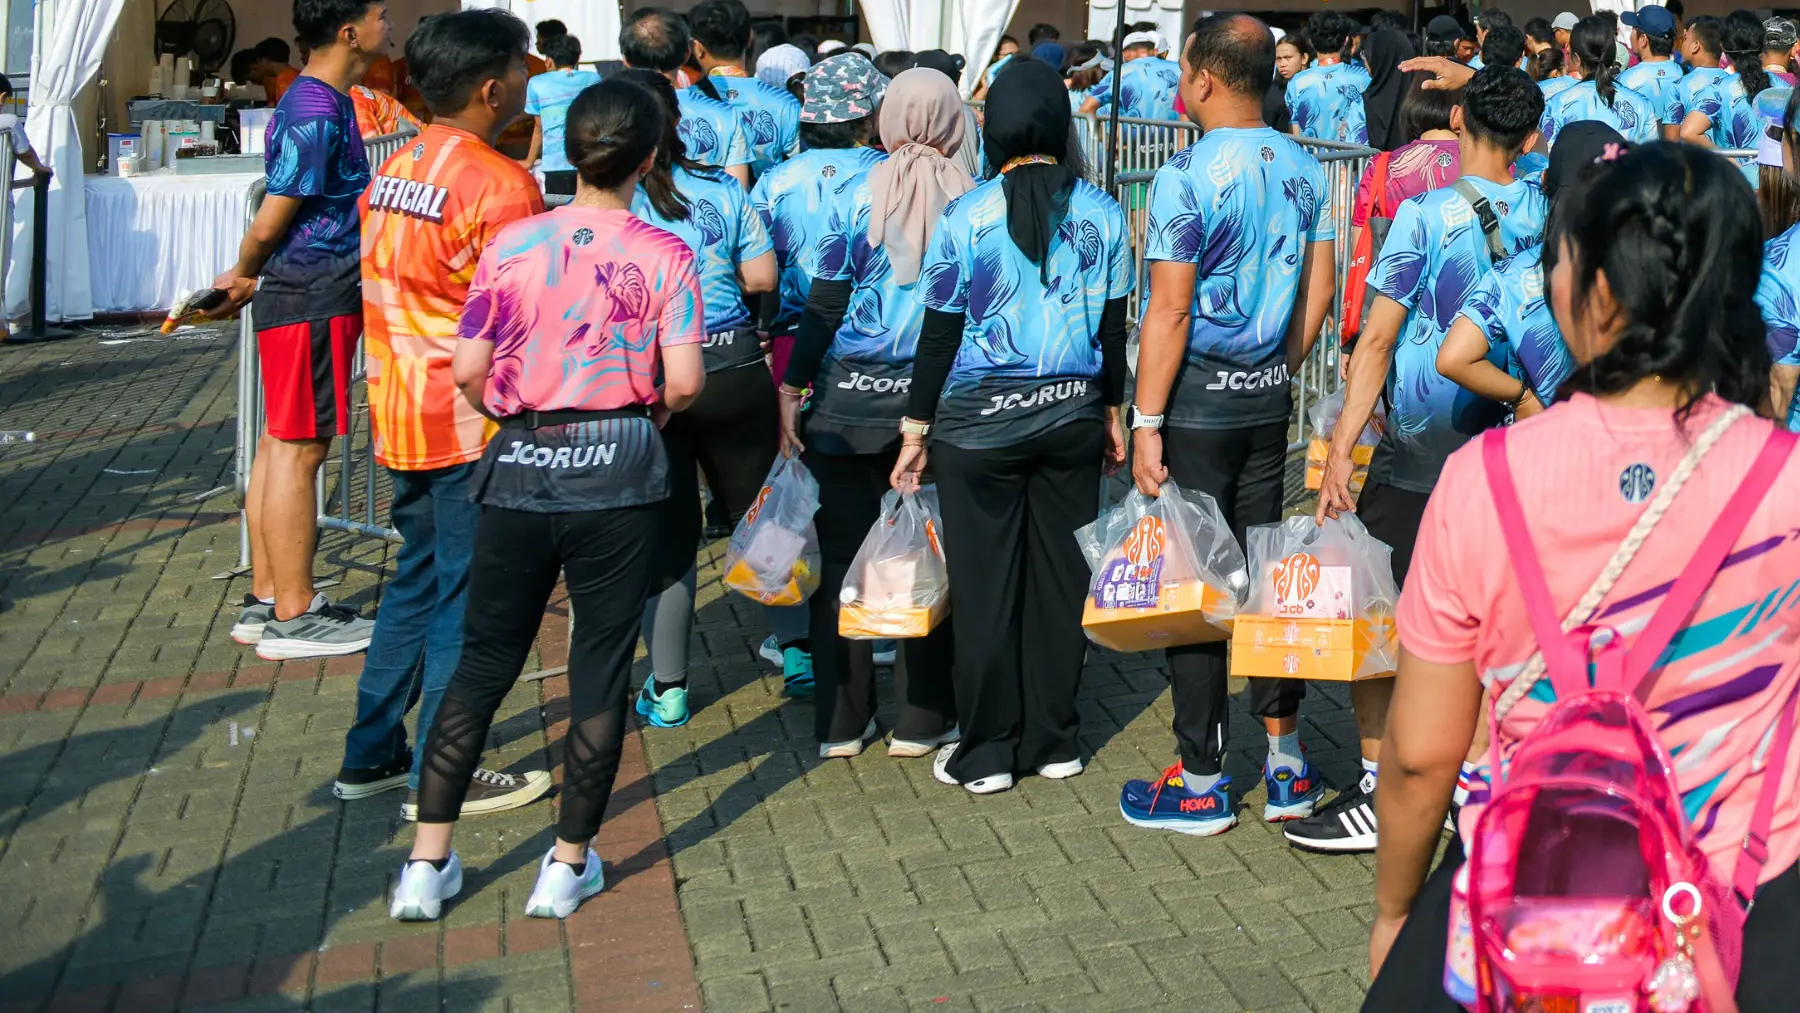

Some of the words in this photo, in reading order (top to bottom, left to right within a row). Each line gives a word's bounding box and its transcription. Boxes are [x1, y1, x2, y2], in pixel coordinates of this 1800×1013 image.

[369, 175, 448, 219] OFFICIAL
[837, 372, 913, 394] JCOR
[980, 380, 1087, 415] JCORUN
[498, 441, 618, 469] JCORUN
[1180, 796, 1216, 812] HOKA
